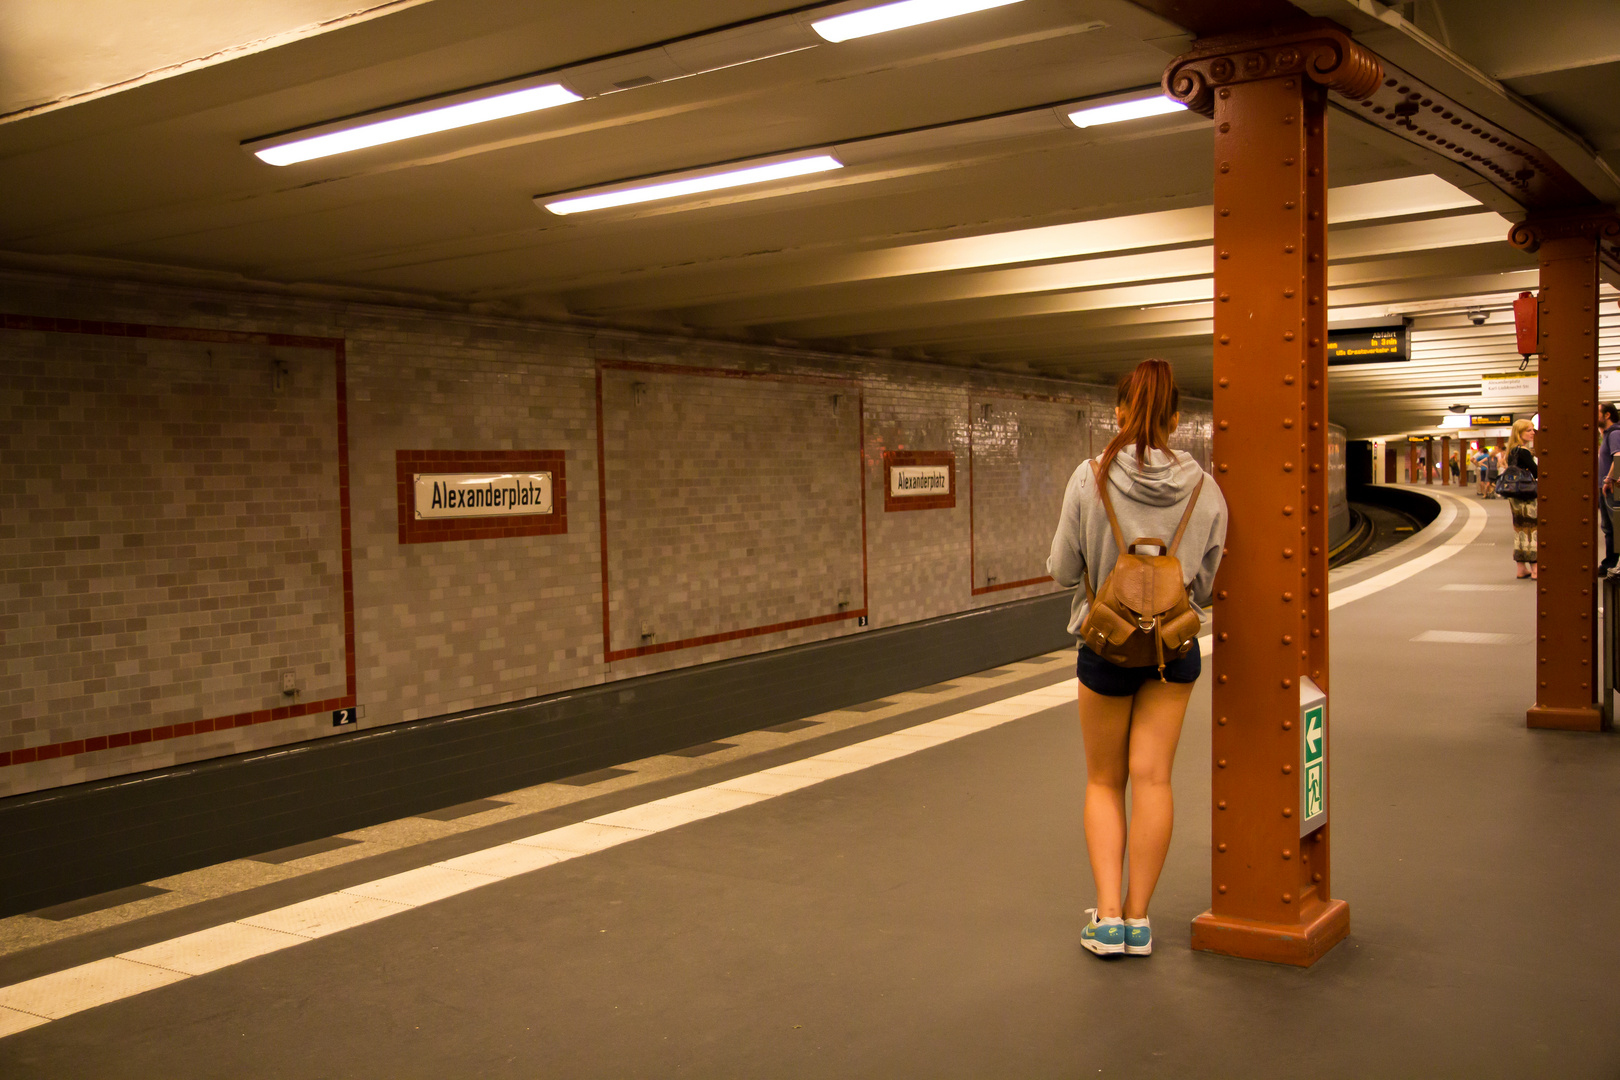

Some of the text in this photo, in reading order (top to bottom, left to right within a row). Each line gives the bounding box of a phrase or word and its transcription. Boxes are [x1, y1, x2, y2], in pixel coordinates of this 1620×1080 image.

[897, 471, 945, 491] Alexanderplatz
[431, 479, 542, 510] Alexanderplatz
[340, 709, 349, 725] 2
